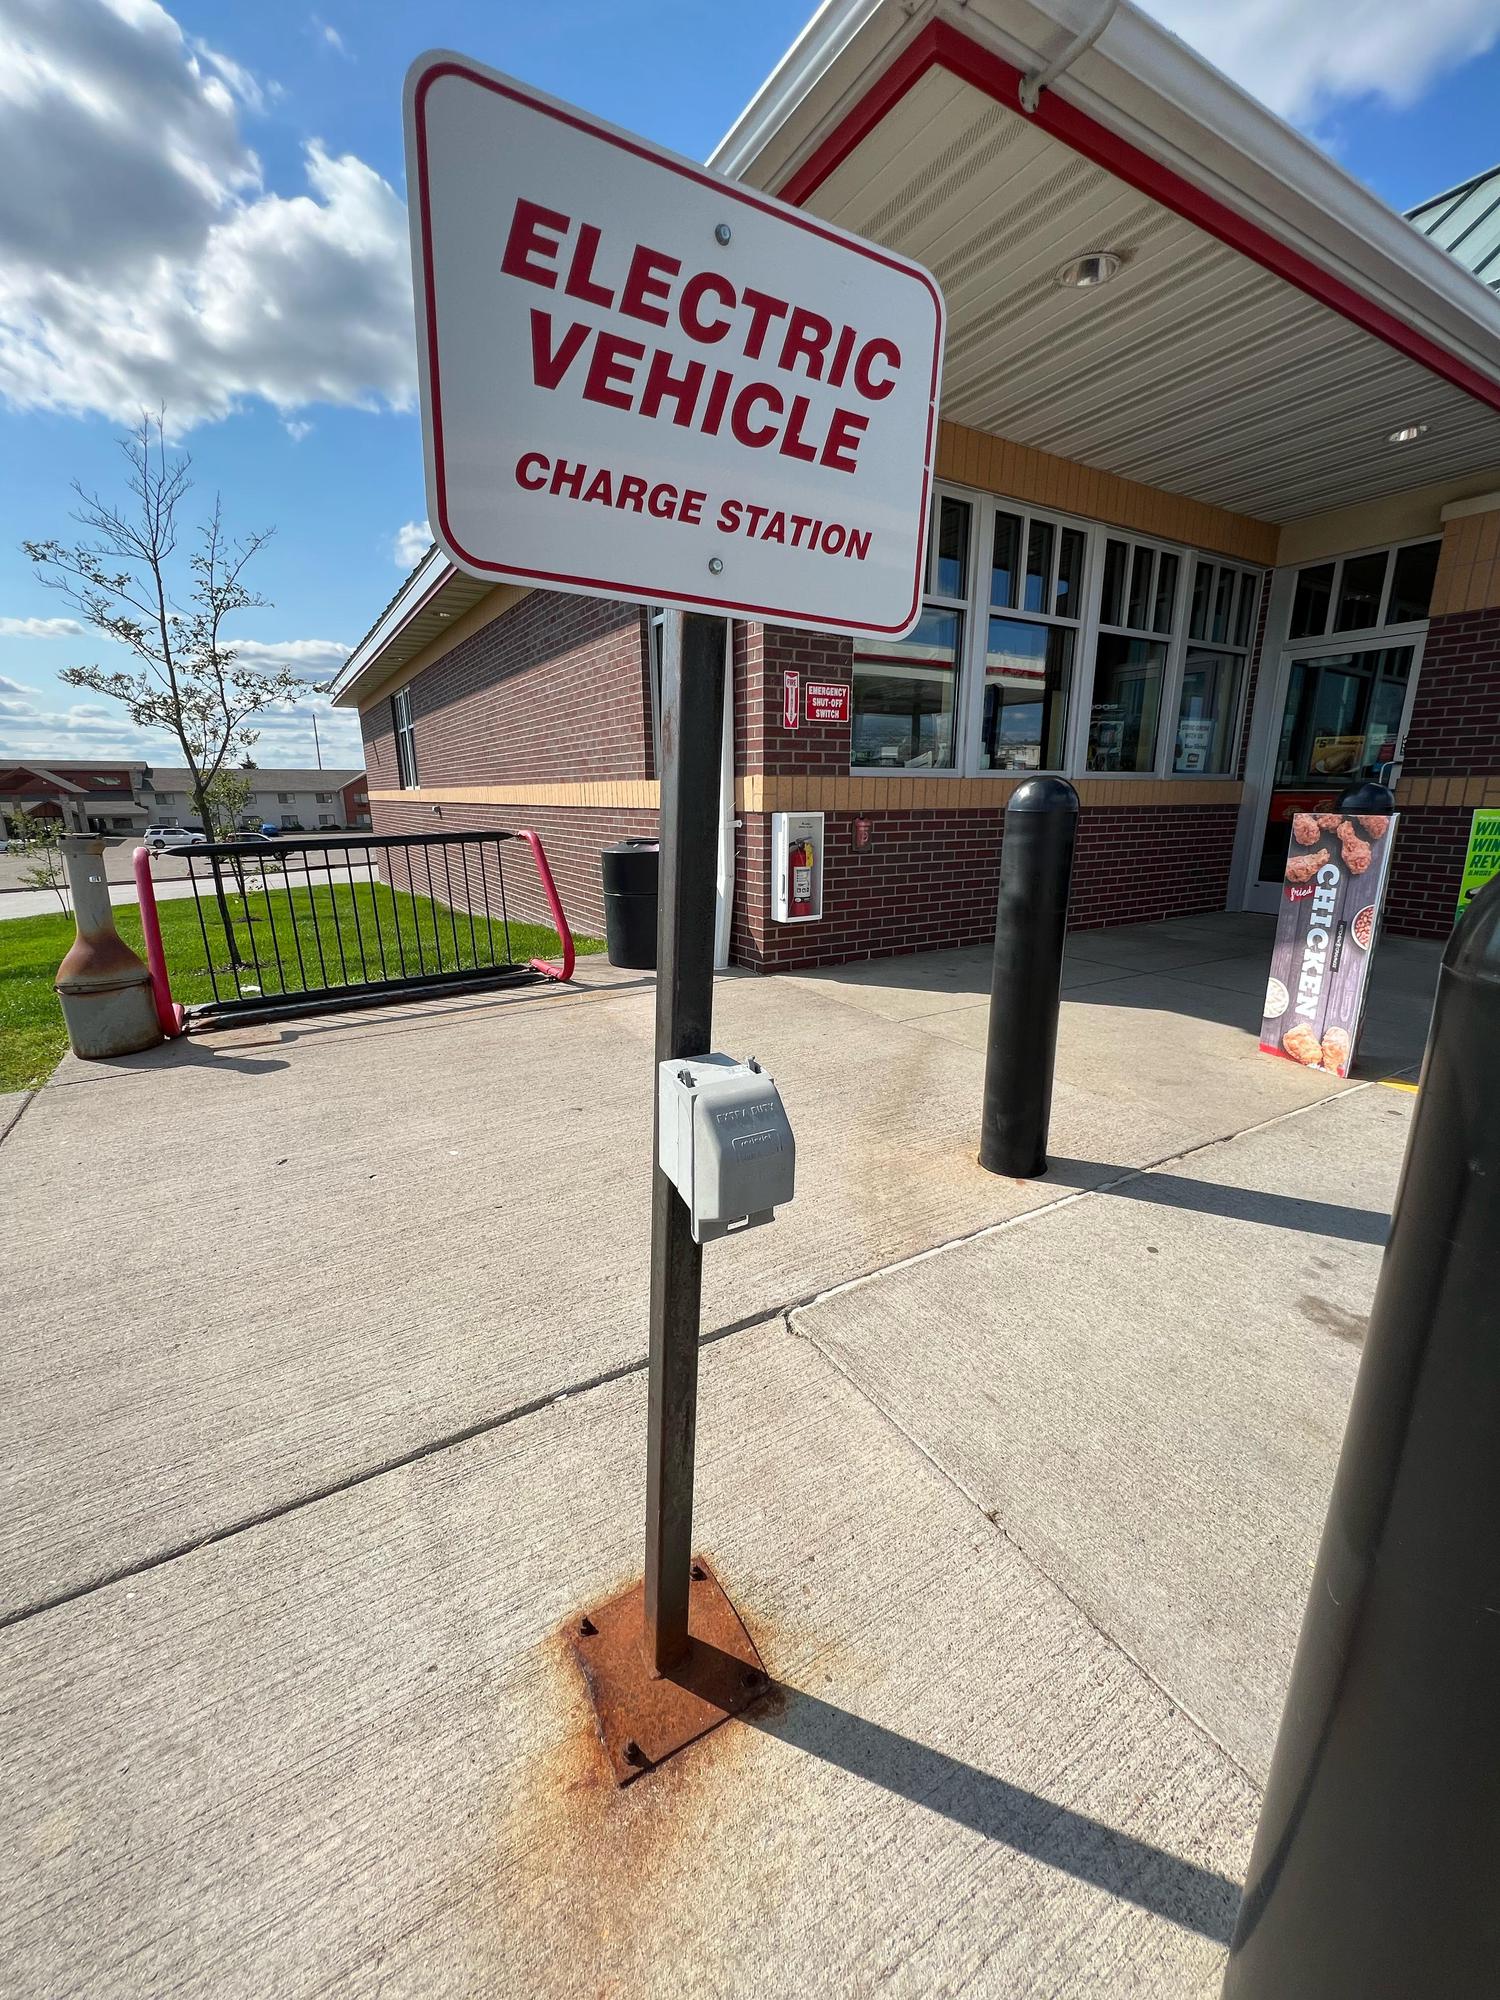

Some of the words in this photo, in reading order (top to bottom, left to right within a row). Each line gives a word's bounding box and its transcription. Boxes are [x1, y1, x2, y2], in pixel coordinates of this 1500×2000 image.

[501, 197, 901, 400] ELECTRIC
[529, 307, 870, 474] VEHICLE
[515, 452, 707, 525] CHARGE
[716, 499, 872, 561] STATION
[808, 686, 847, 697] EMERGENCY
[812, 698, 843, 708] SHUT-OFF
[815, 709, 840, 719] SWITCH
[1470, 855, 1500, 868] REV
[1290, 885, 1313, 902] fried
[1294, 863, 1340, 1020] CHICKEN
